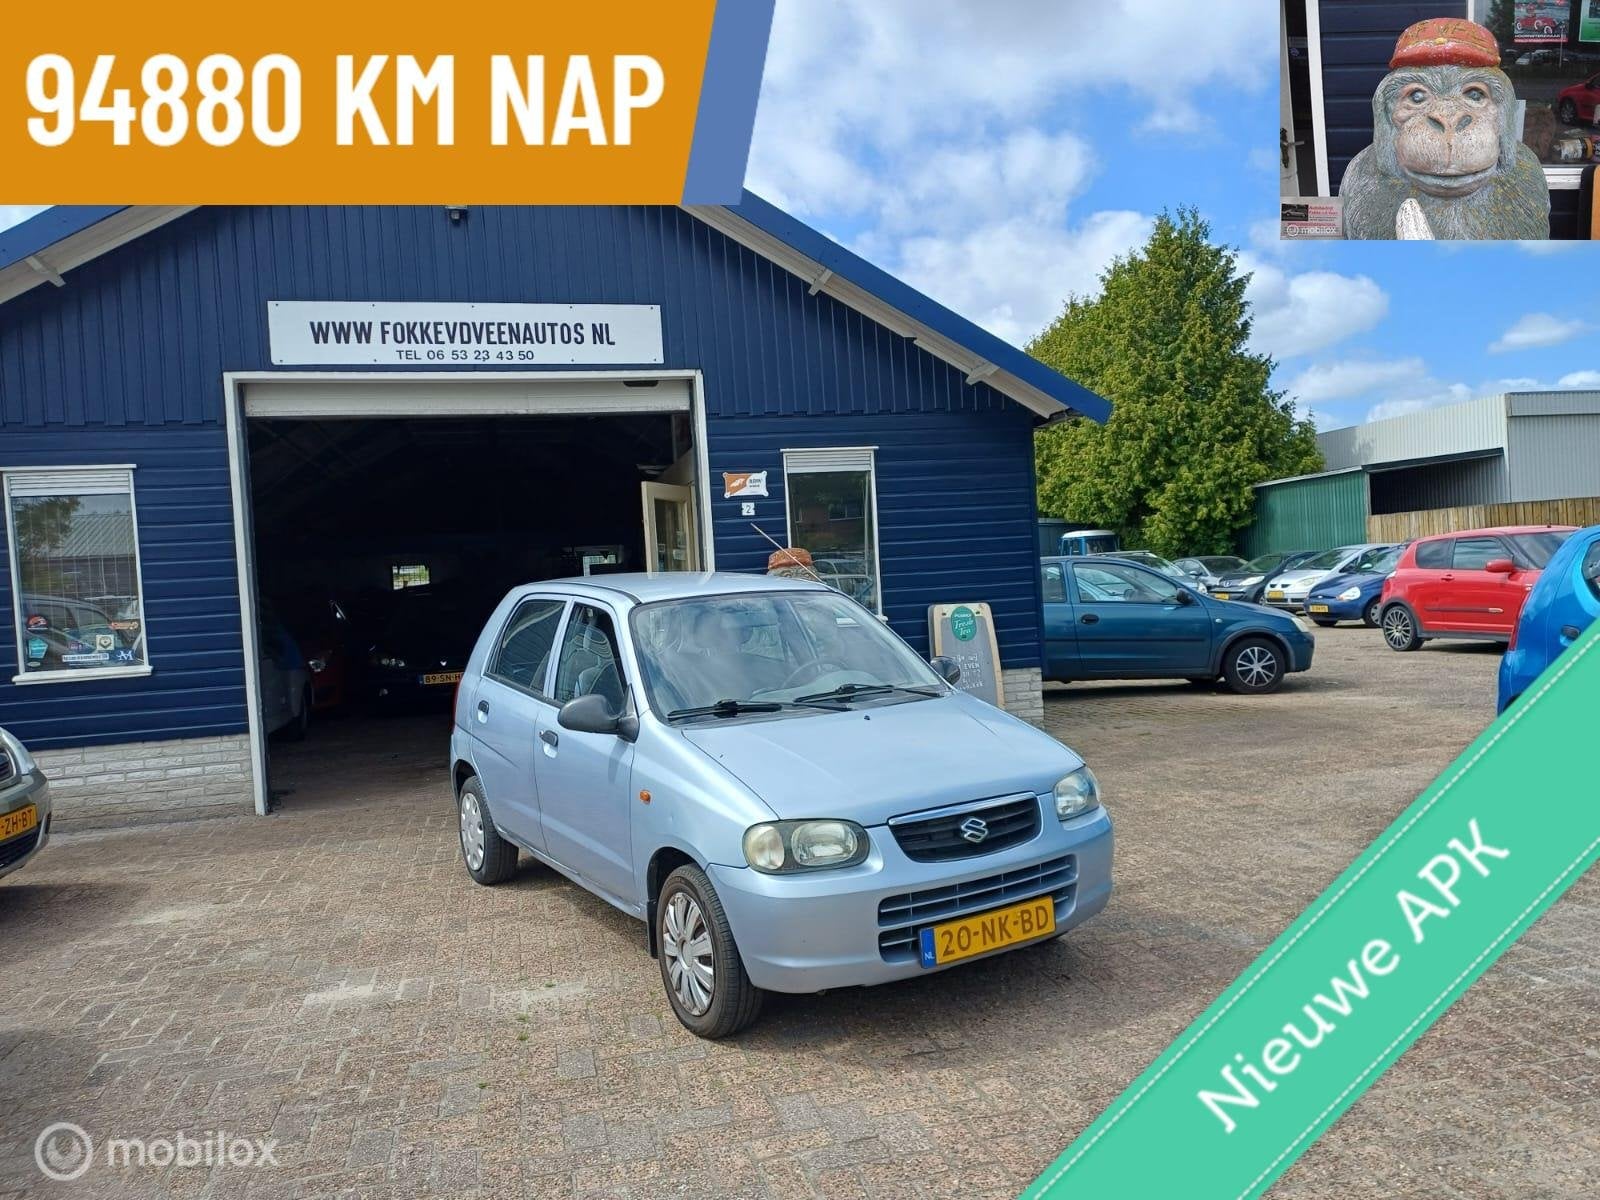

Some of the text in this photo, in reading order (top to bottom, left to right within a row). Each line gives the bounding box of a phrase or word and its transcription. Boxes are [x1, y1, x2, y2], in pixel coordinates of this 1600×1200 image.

[309, 321, 616, 346] WWW FOKKEVDVEENAUTOS NL
[396, 350, 535, 362] TEL 06 53 23 43 50
[924, 905, 1049, 961] NL 20-NK-BD
